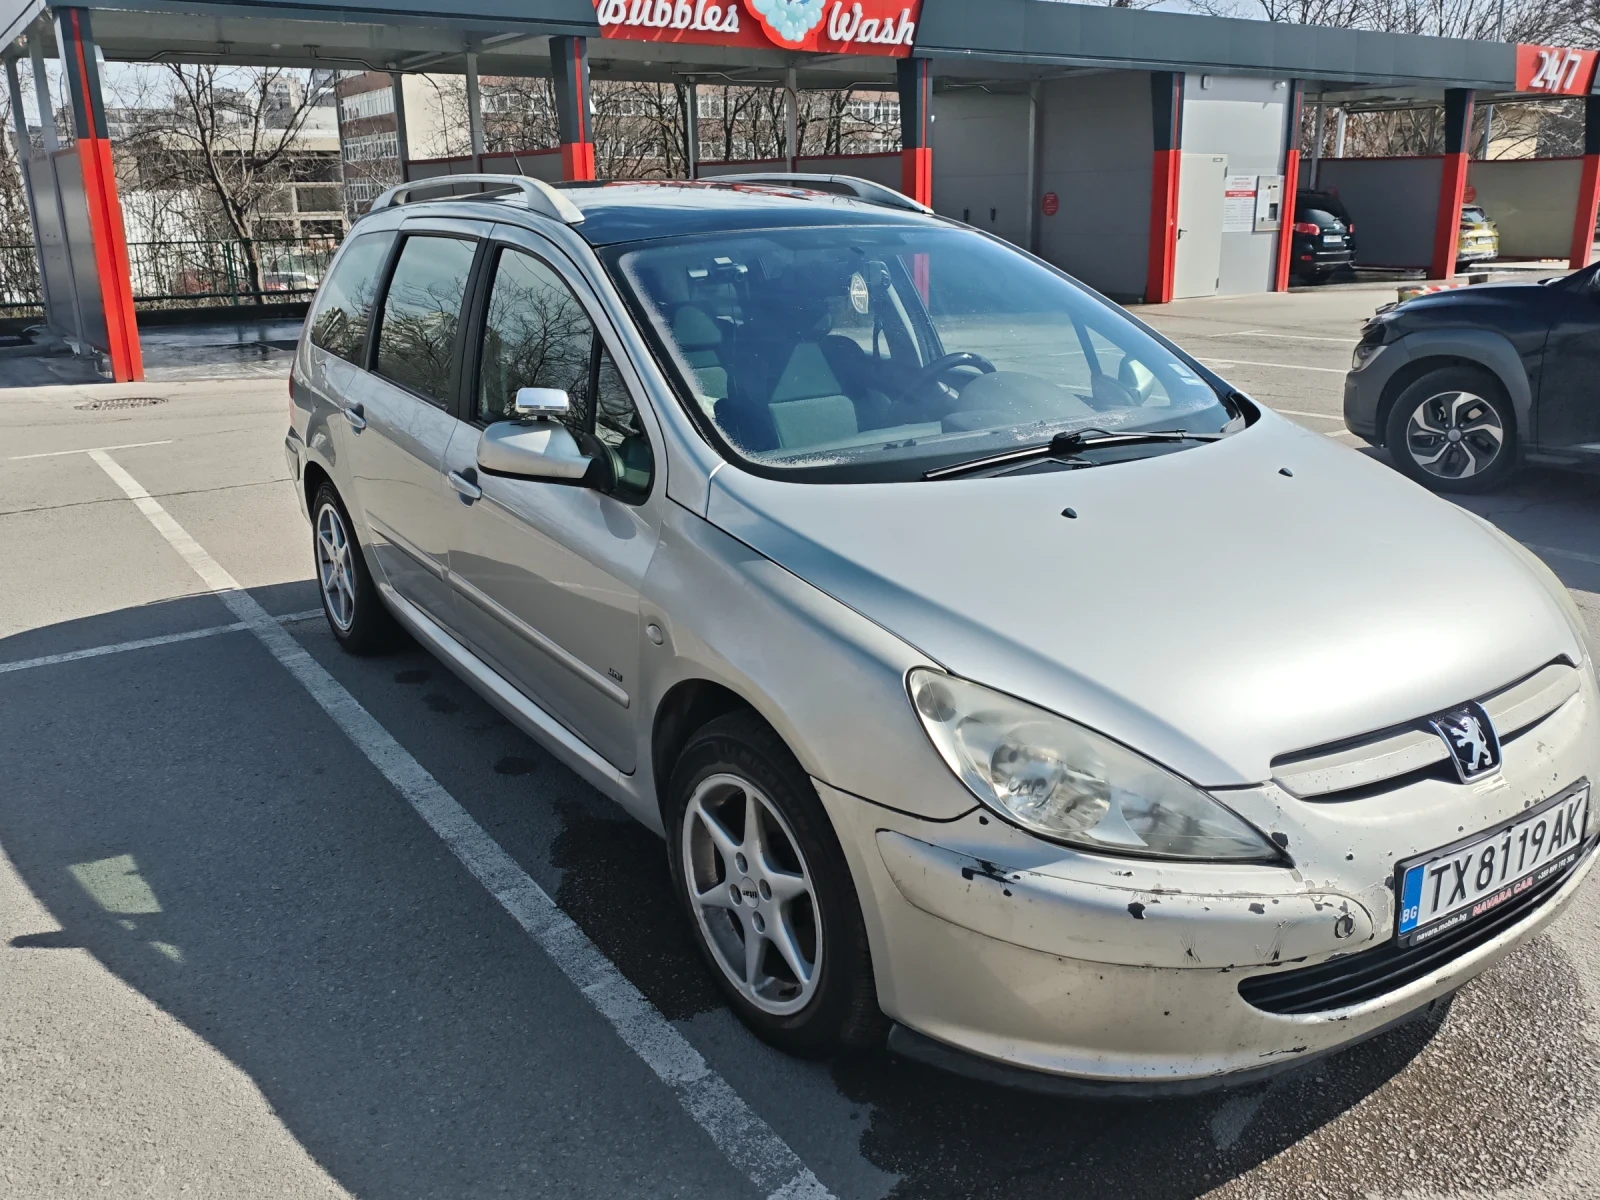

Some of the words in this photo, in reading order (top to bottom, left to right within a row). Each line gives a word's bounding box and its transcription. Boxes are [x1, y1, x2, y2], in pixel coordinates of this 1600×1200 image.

[598, 0, 740, 33] Bubbles
[827, 1, 914, 46] Wash
[1529, 47, 1582, 93] 24/7
[1402, 905, 1418, 923] BG
[1416, 913, 1467, 942] navara.mobile.bg
[1472, 888, 1512, 917] NAVARA
[1513, 876, 1533, 895] CAR
